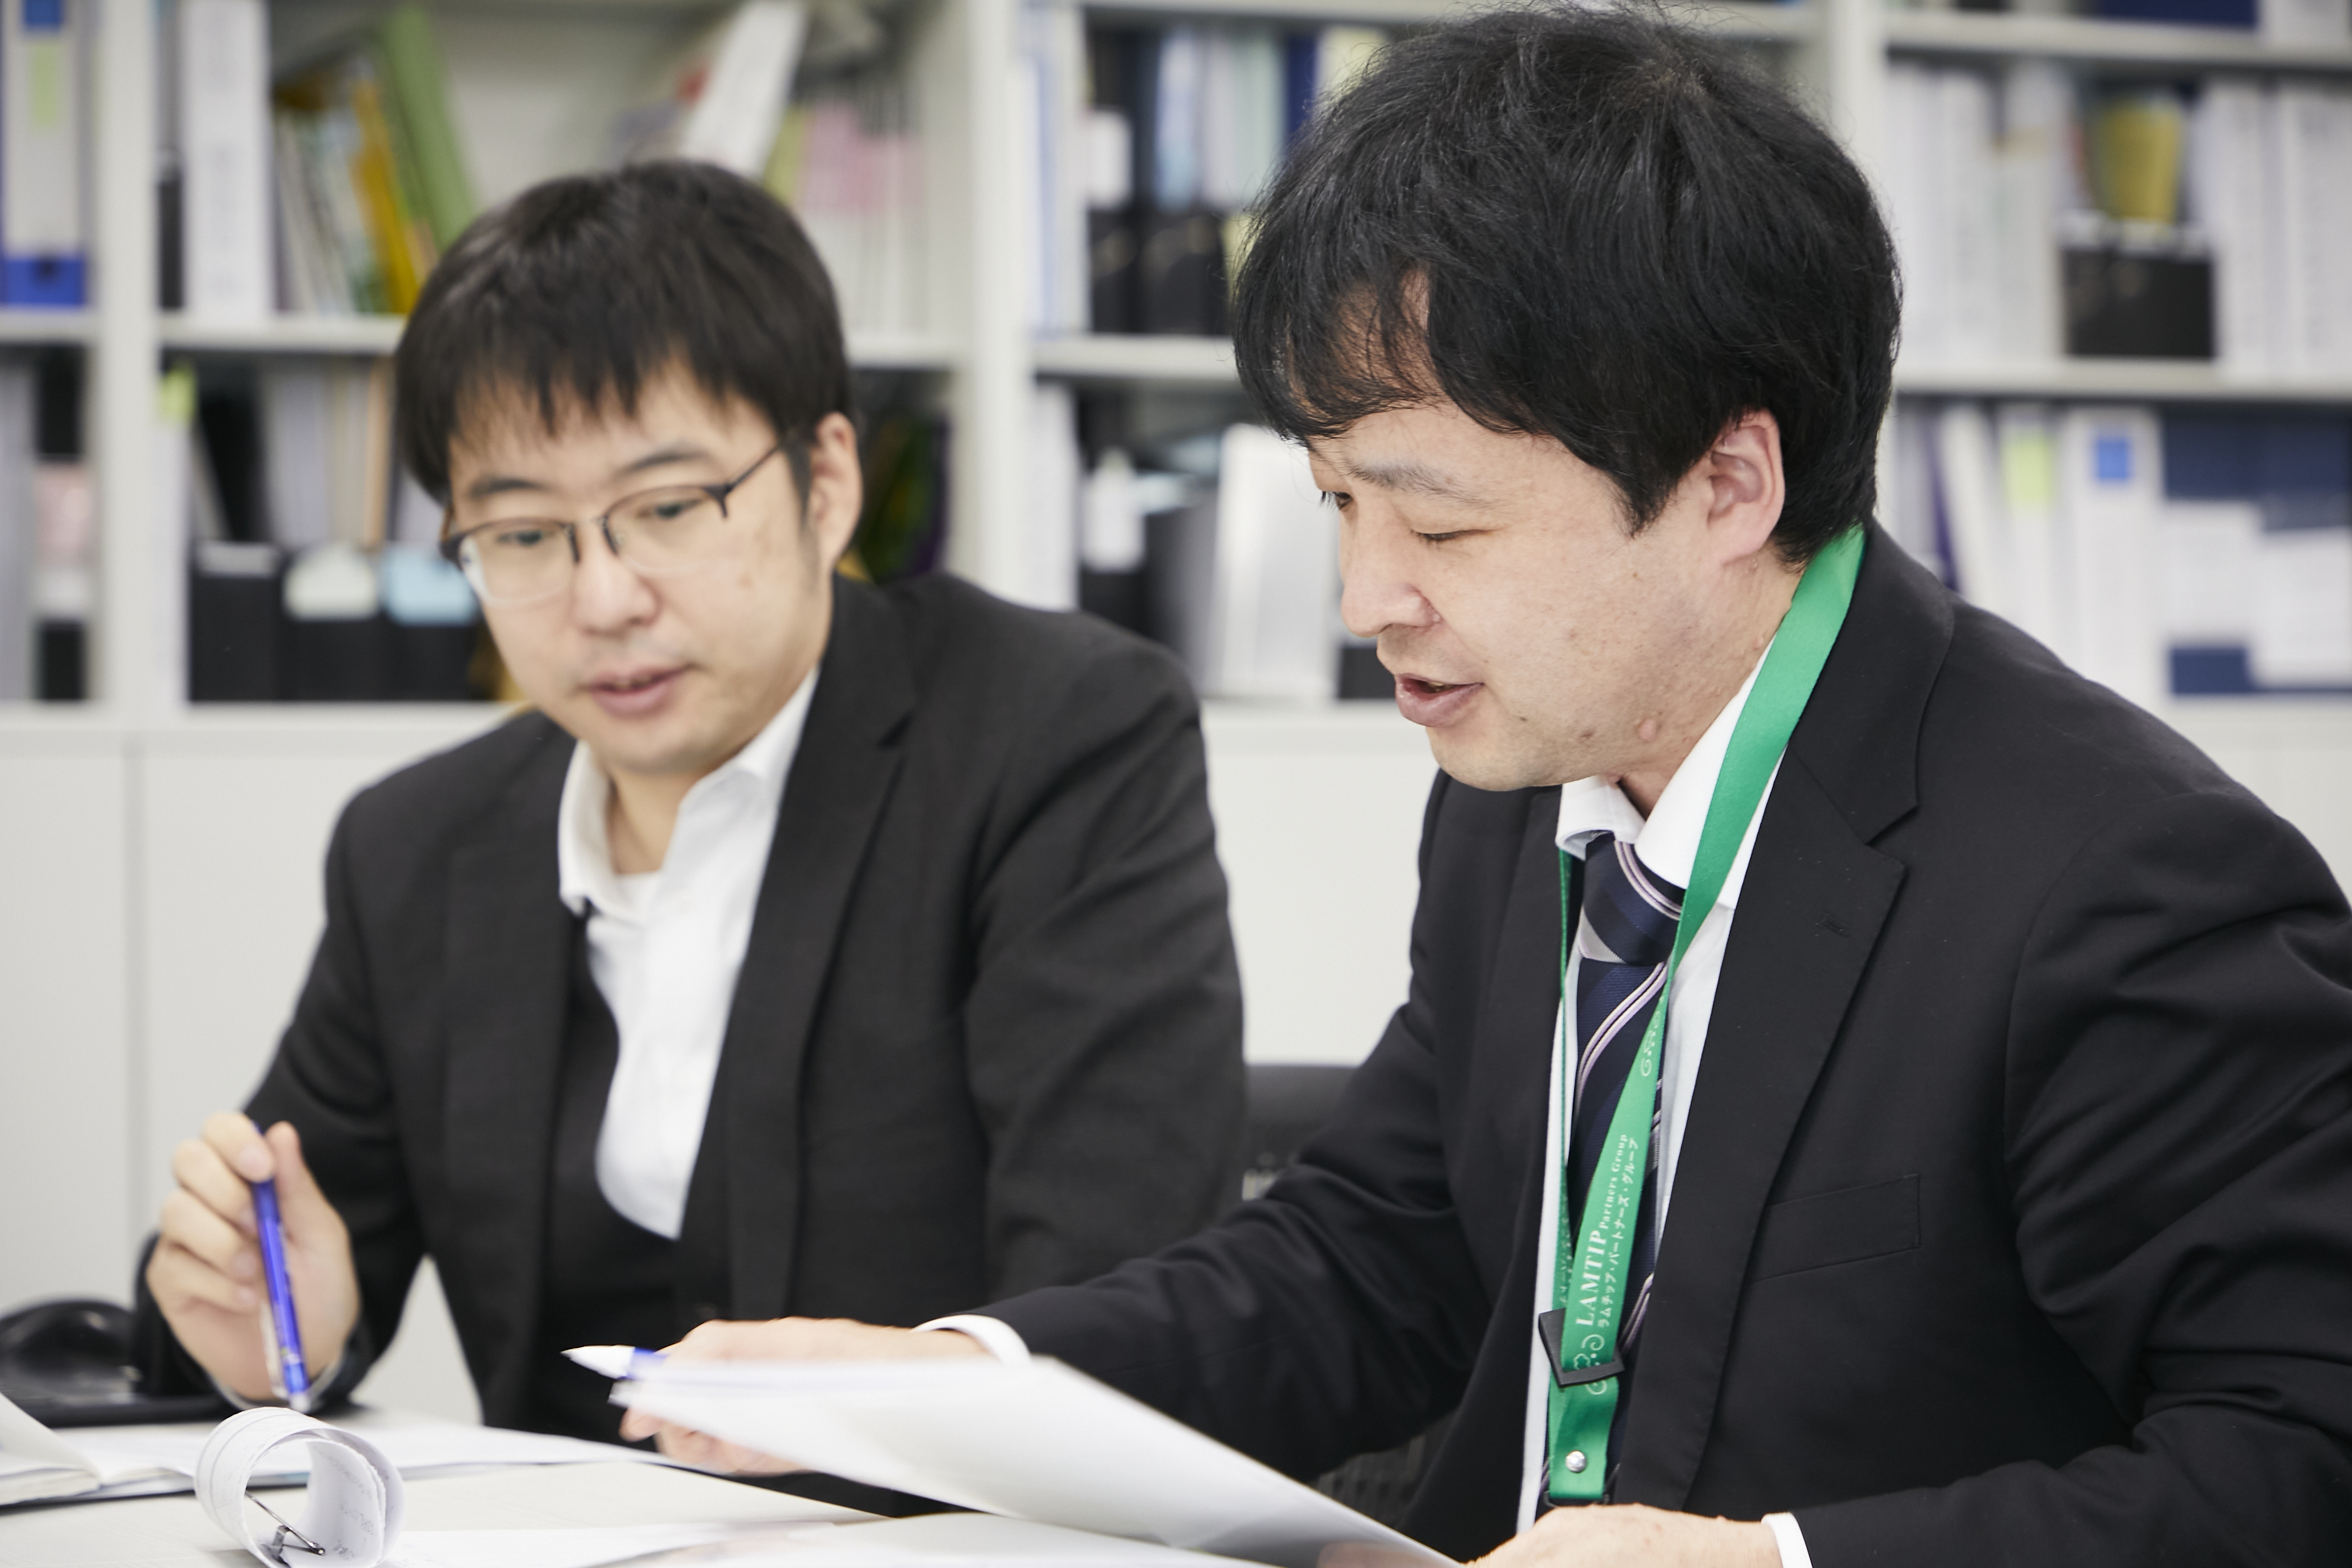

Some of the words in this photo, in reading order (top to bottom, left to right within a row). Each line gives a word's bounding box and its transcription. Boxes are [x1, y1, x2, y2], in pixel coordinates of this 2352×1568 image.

[1576, 1230, 1606, 1326] LAMTIP
[1599, 1177, 1618, 1229] Partners
[1611, 1135, 1628, 1172] Group
